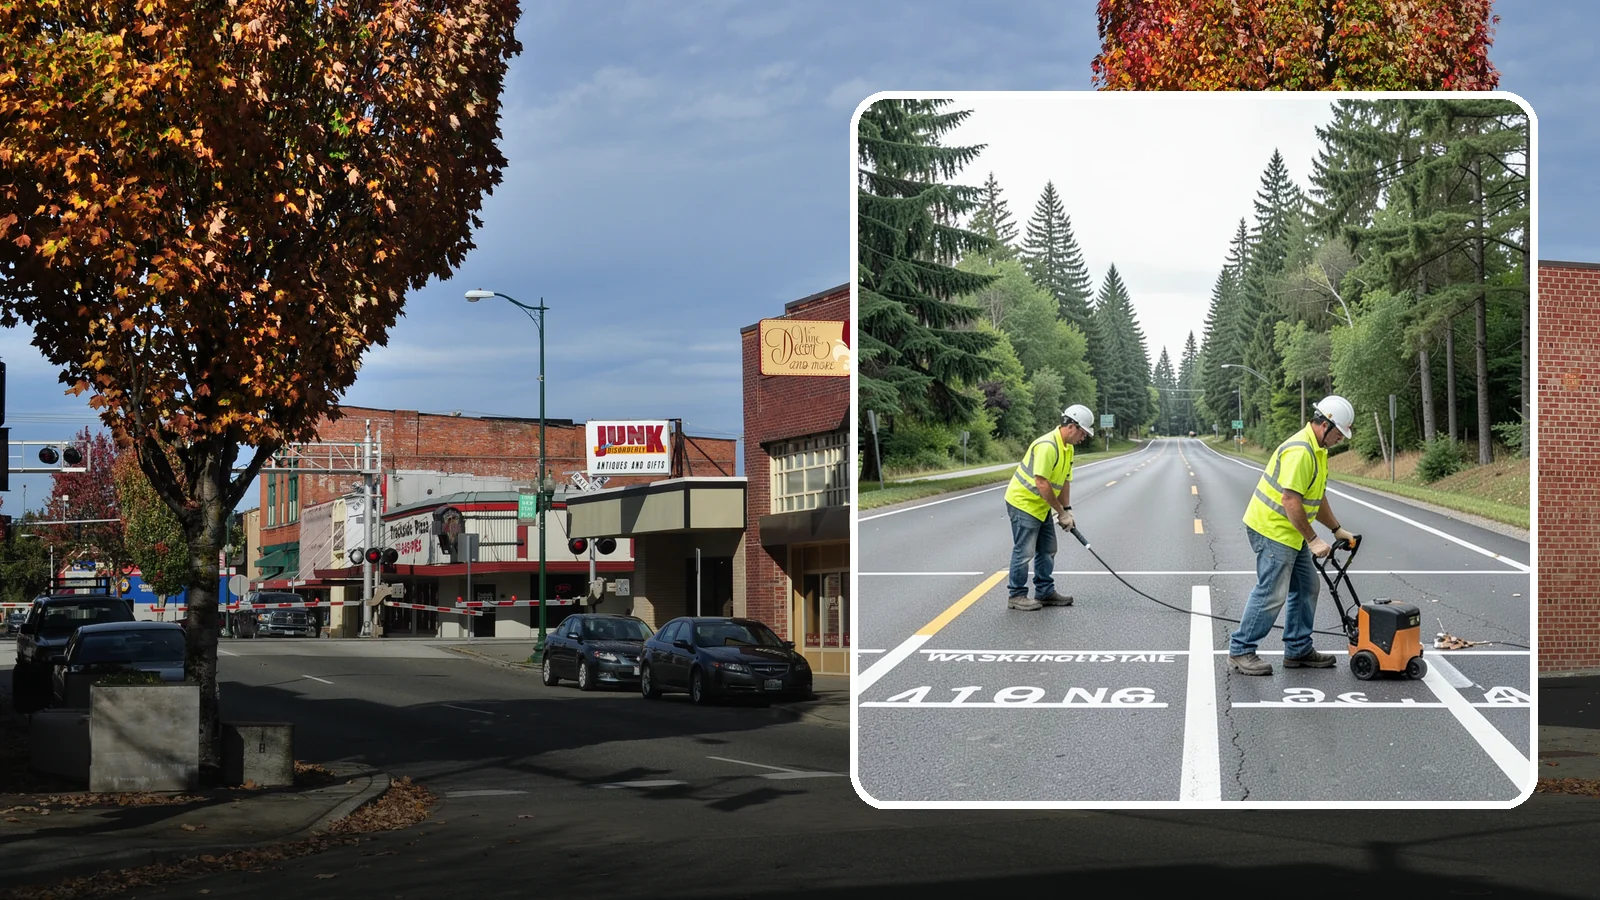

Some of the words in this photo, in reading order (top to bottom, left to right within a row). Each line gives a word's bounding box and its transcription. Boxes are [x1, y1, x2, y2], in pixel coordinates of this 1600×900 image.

[765, 328, 831, 365] Decor
[595, 425, 664, 457] JUNK
[607, 446, 646, 454] DISORDERLY
[596, 461, 628, 470] ANTIQUES
[631, 461, 644, 470] AND
[647, 460, 665, 470] GIFTS
[390, 522, 413, 540] Trackside
[414, 519, 429, 535] Pizza
